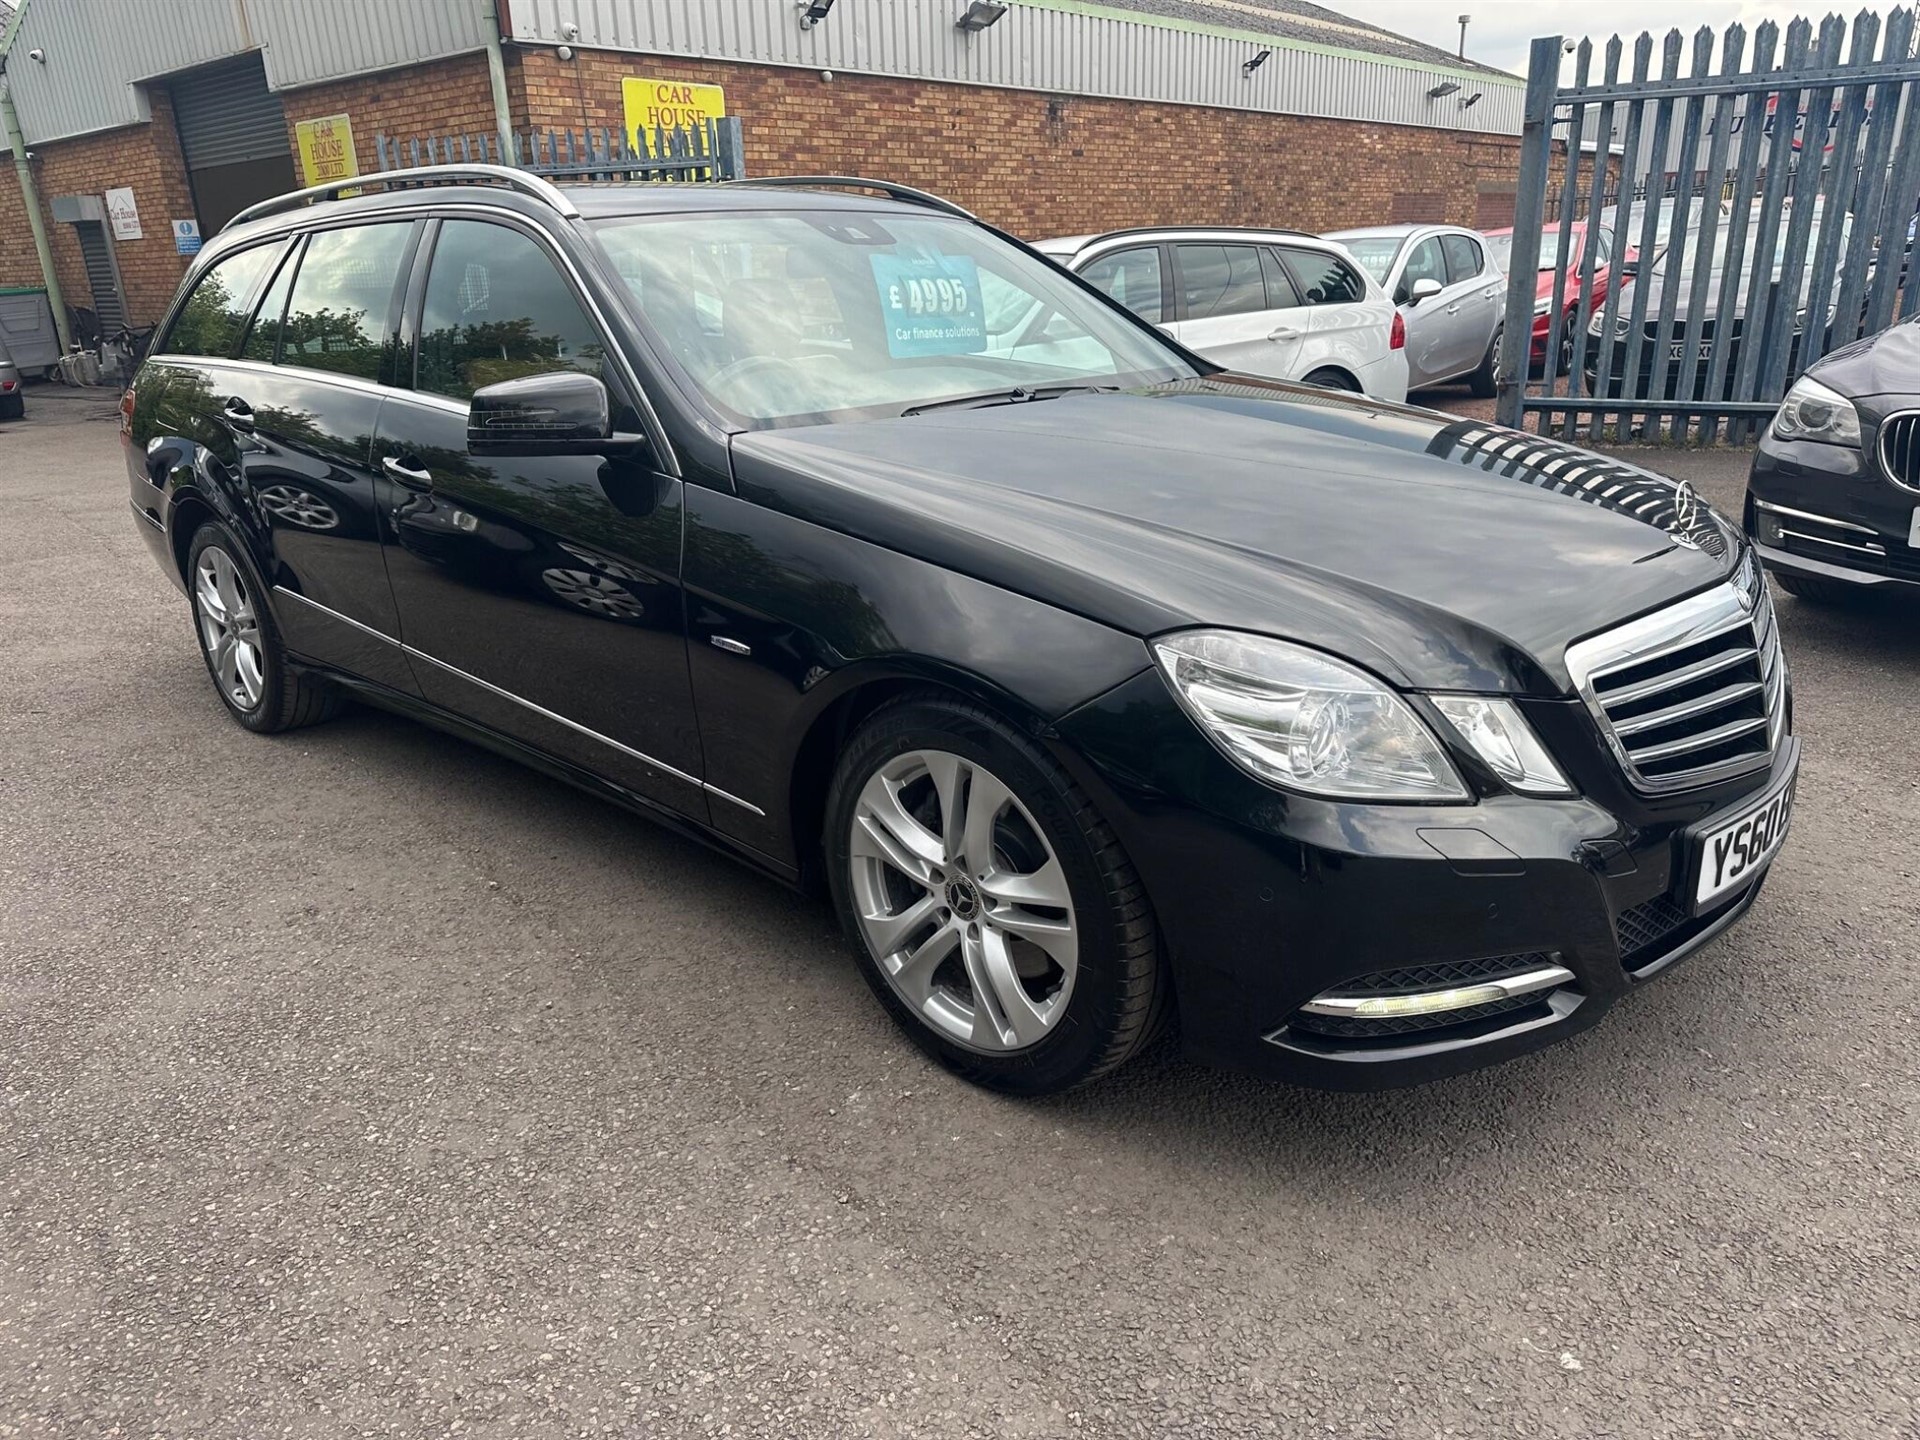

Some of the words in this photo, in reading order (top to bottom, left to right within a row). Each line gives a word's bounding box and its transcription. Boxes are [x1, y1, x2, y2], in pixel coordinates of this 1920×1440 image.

[656, 84, 695, 104] CAR
[647, 106, 705, 127] HOUSE
[313, 120, 335, 138] CAR
[310, 140, 344, 160] HOUSE
[895, 328, 911, 340] Car
[913, 327, 944, 339] finance
[945, 325, 980, 337] solutions
